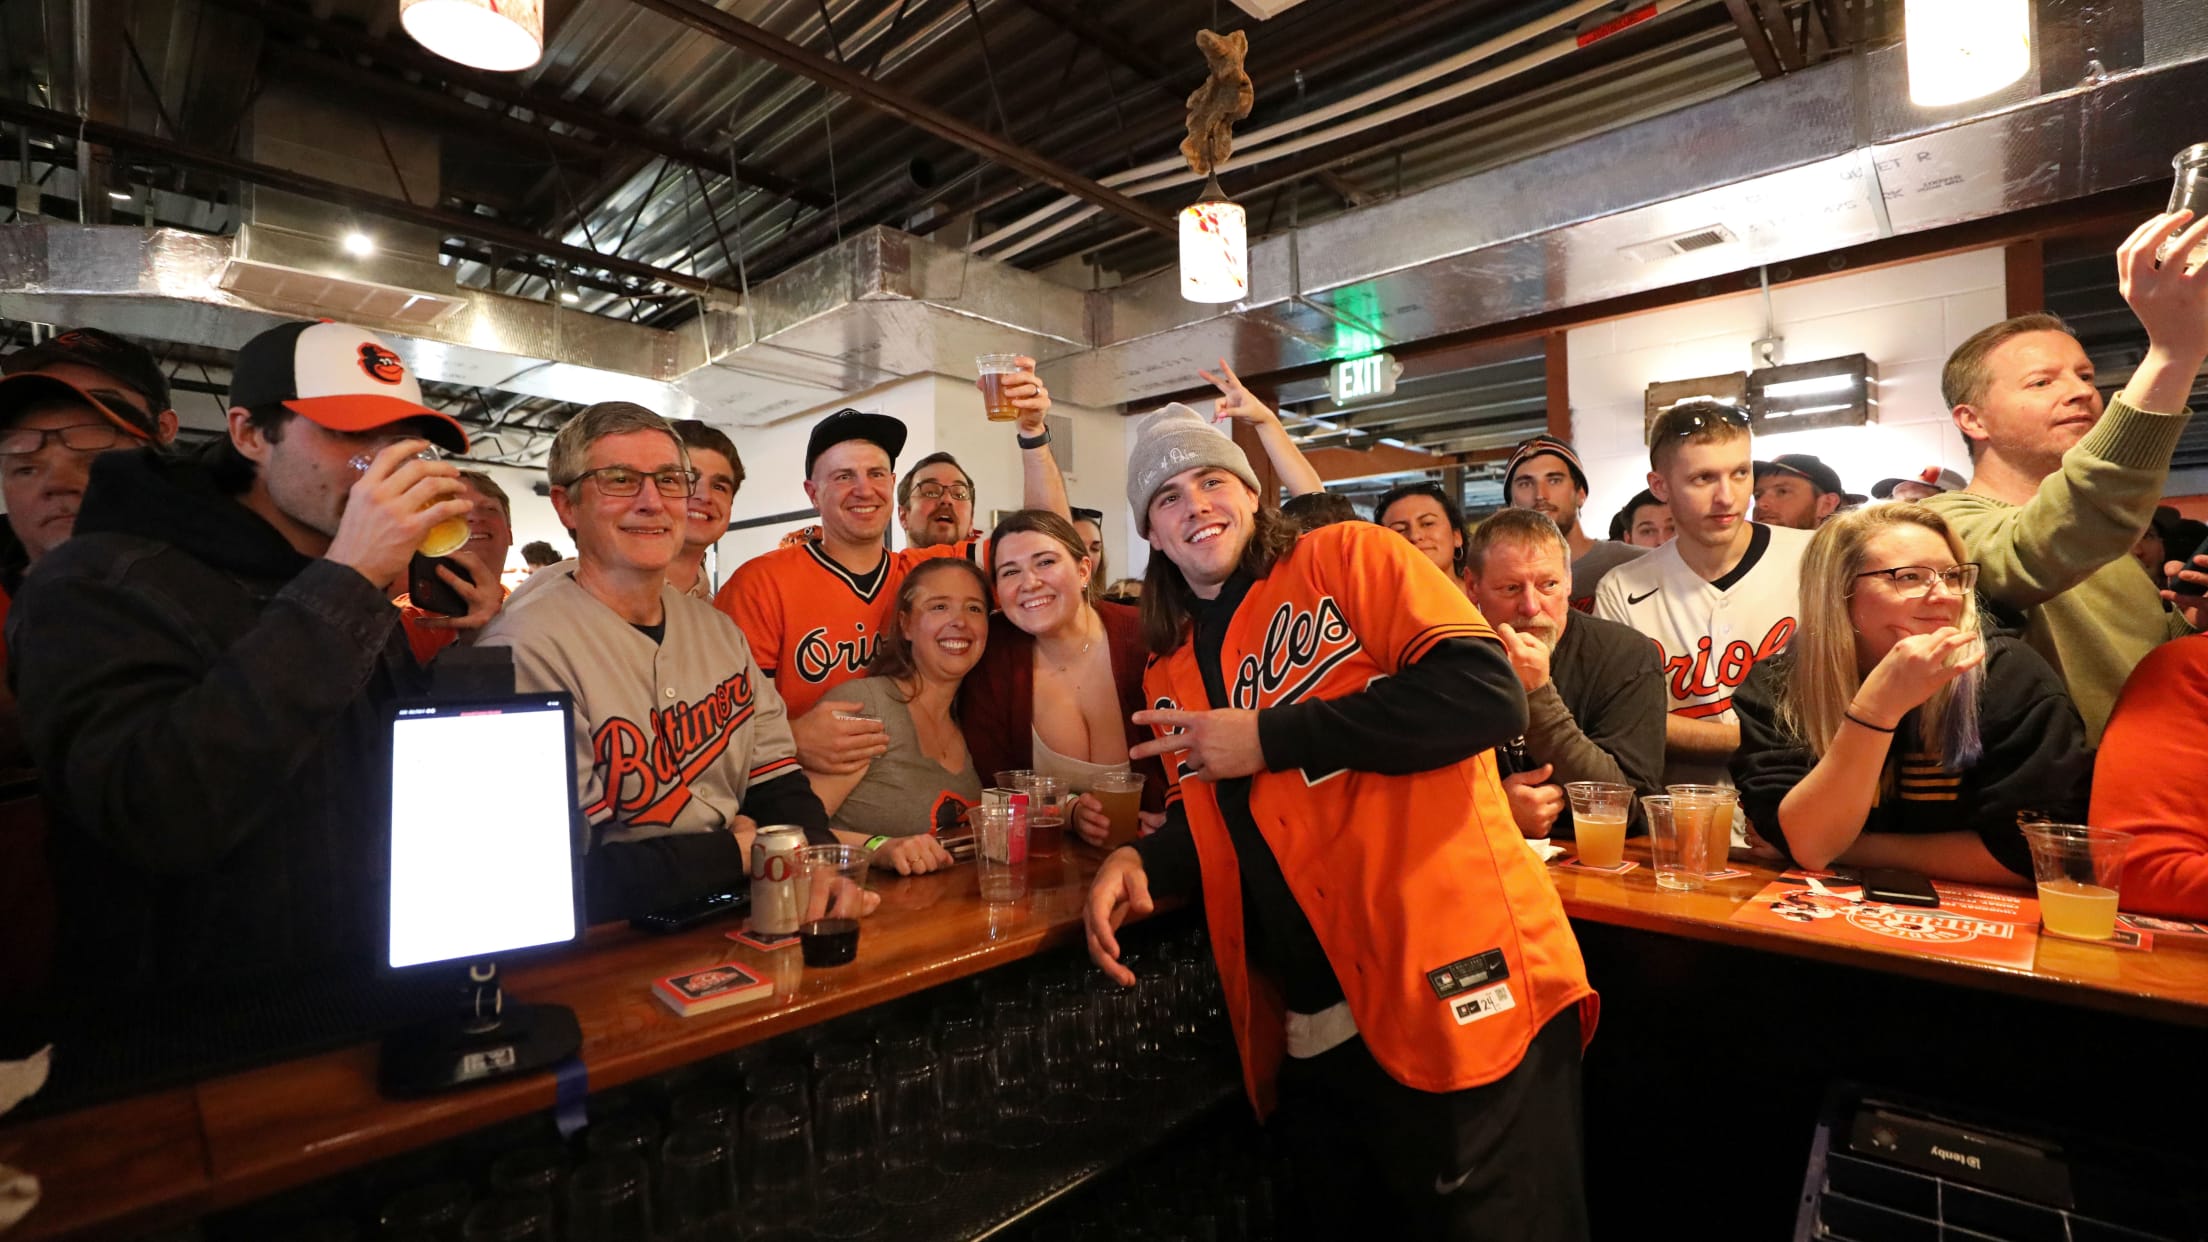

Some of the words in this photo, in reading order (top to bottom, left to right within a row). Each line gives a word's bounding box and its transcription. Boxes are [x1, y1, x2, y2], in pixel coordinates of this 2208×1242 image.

[1339, 354, 1384, 400] EXIT
[1650, 616, 1797, 700] riol
[1930, 1145, 1965, 1165] tenby
